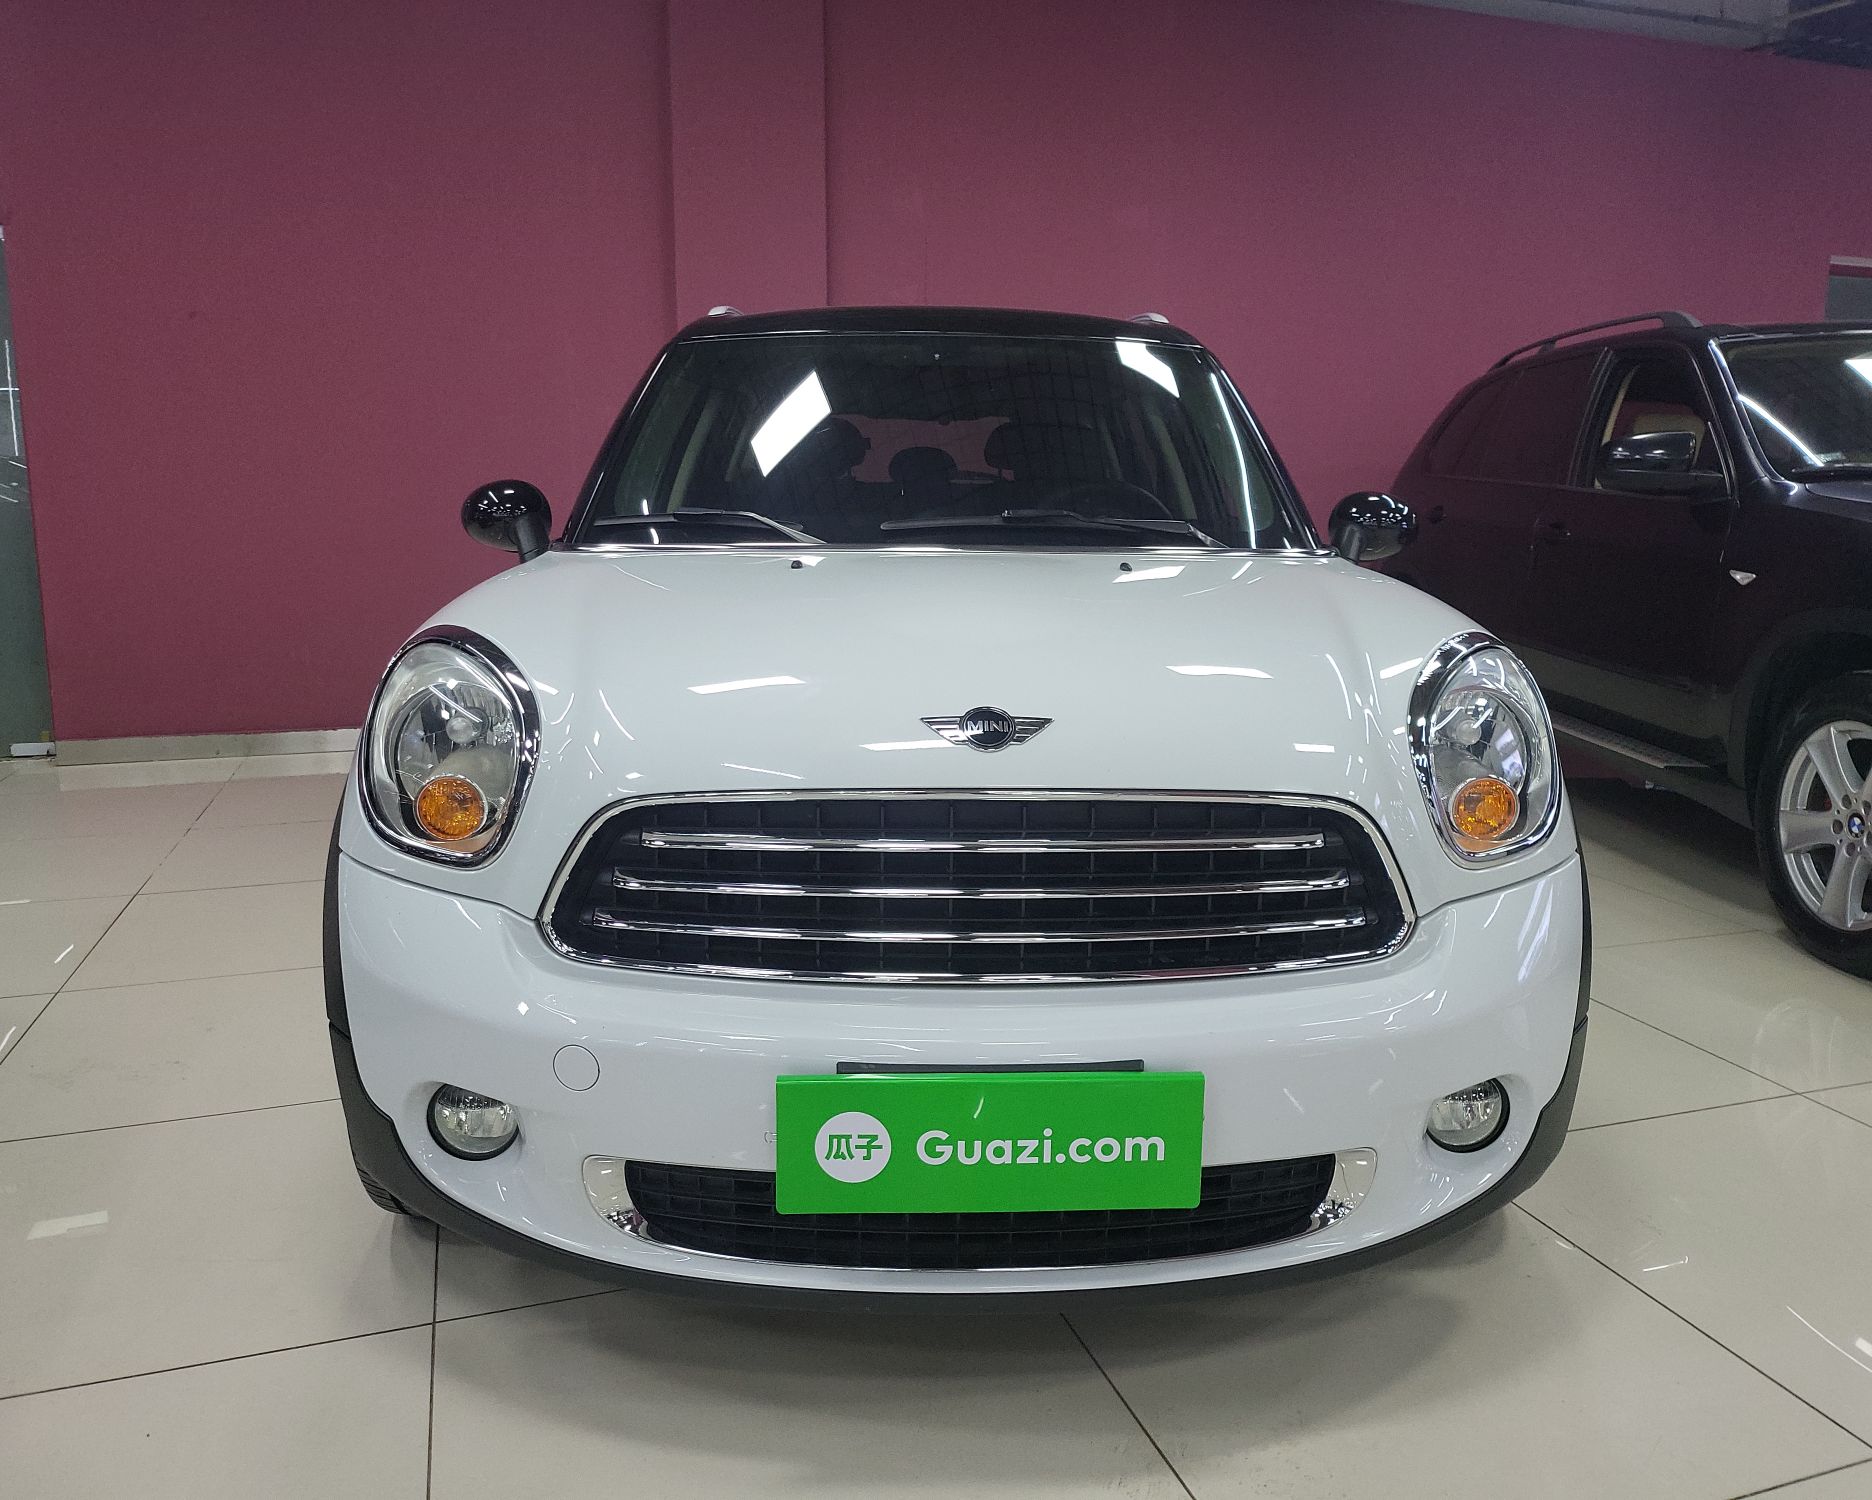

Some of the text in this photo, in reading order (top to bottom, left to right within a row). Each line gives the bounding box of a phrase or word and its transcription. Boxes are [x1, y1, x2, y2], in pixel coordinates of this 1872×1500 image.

[967, 720, 1009, 732] MINI
[825, 1133, 883, 1162] 瓜子
[916, 1128, 1165, 1165] Guazi.com
